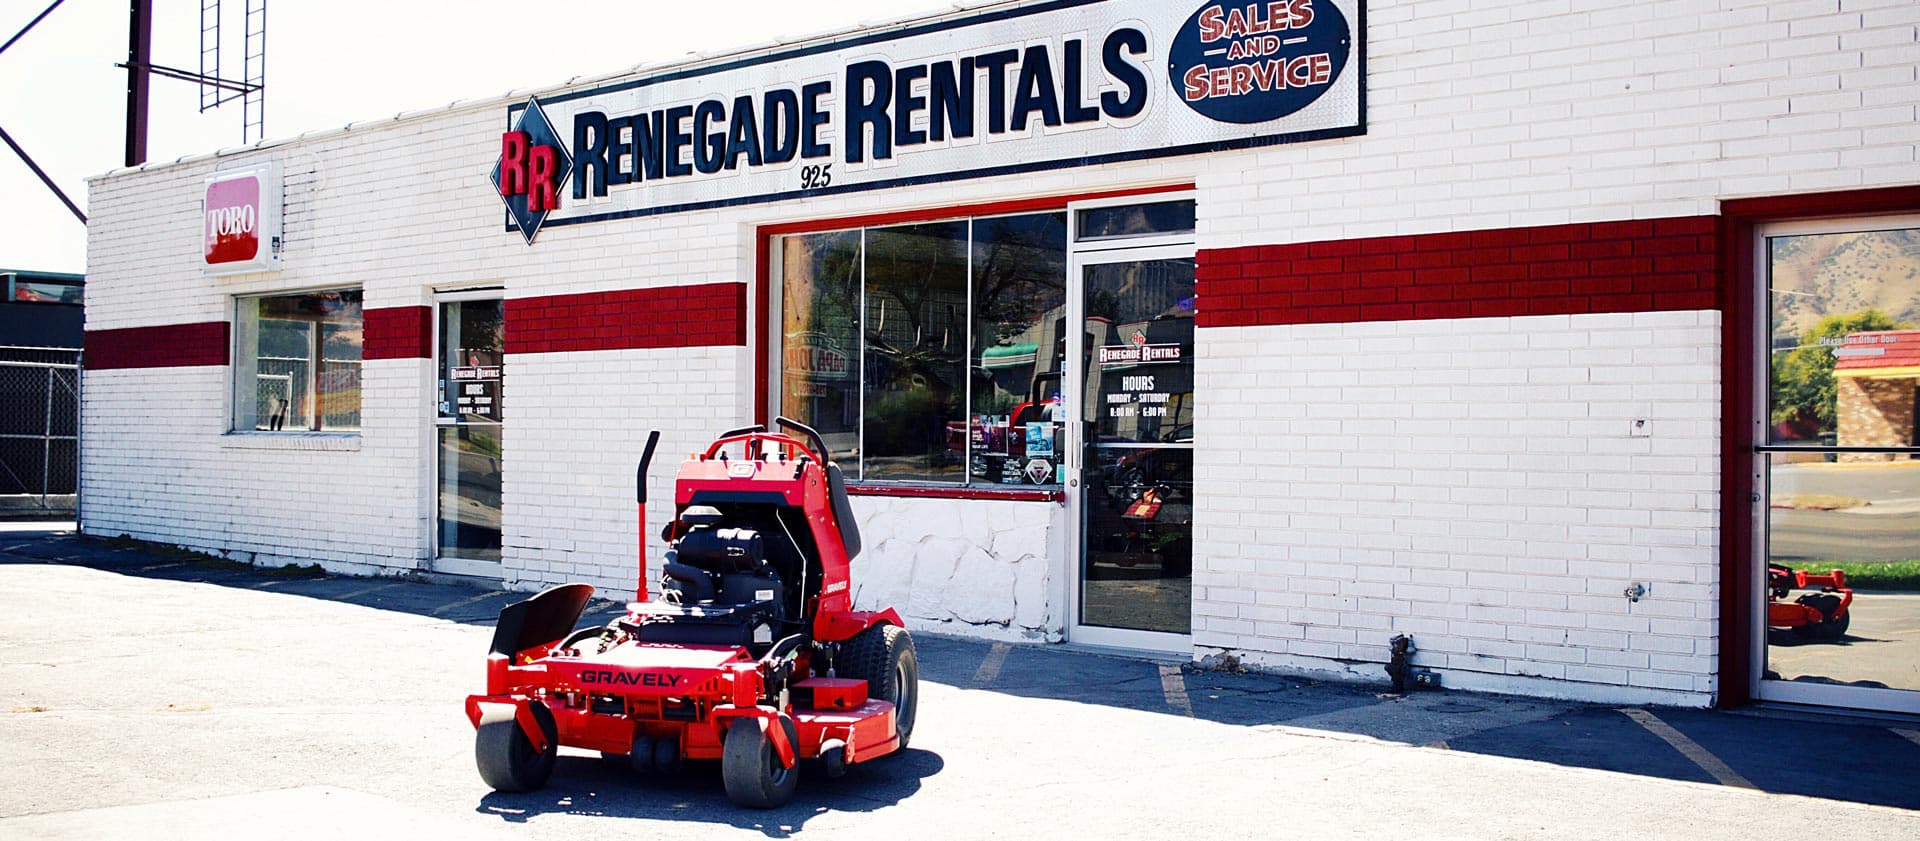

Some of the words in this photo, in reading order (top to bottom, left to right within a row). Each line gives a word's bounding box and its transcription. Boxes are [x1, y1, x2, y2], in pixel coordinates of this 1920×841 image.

[1198, 0, 1315, 43] SALES
[1227, 35, 1281, 61] AND
[1183, 53, 1332, 101] SERVICE
[573, 81, 832, 199] RENEGADE
[845, 28, 1148, 164] RENTALS
[501, 130, 562, 212] RR
[800, 163, 833, 190] 925
[208, 204, 255, 237] TORO
[1099, 348, 1141, 362] RENEGADE
[1142, 346, 1180, 361] RENTALS
[1122, 375, 1155, 391] HOURS
[1107, 394, 1131, 403] MONDAY
[1139, 393, 1170, 403] SATURDAY
[1125, 407, 1135, 417] AM
[1158, 406, 1167, 417] PM
[582, 669, 682, 688] GRAVELY
